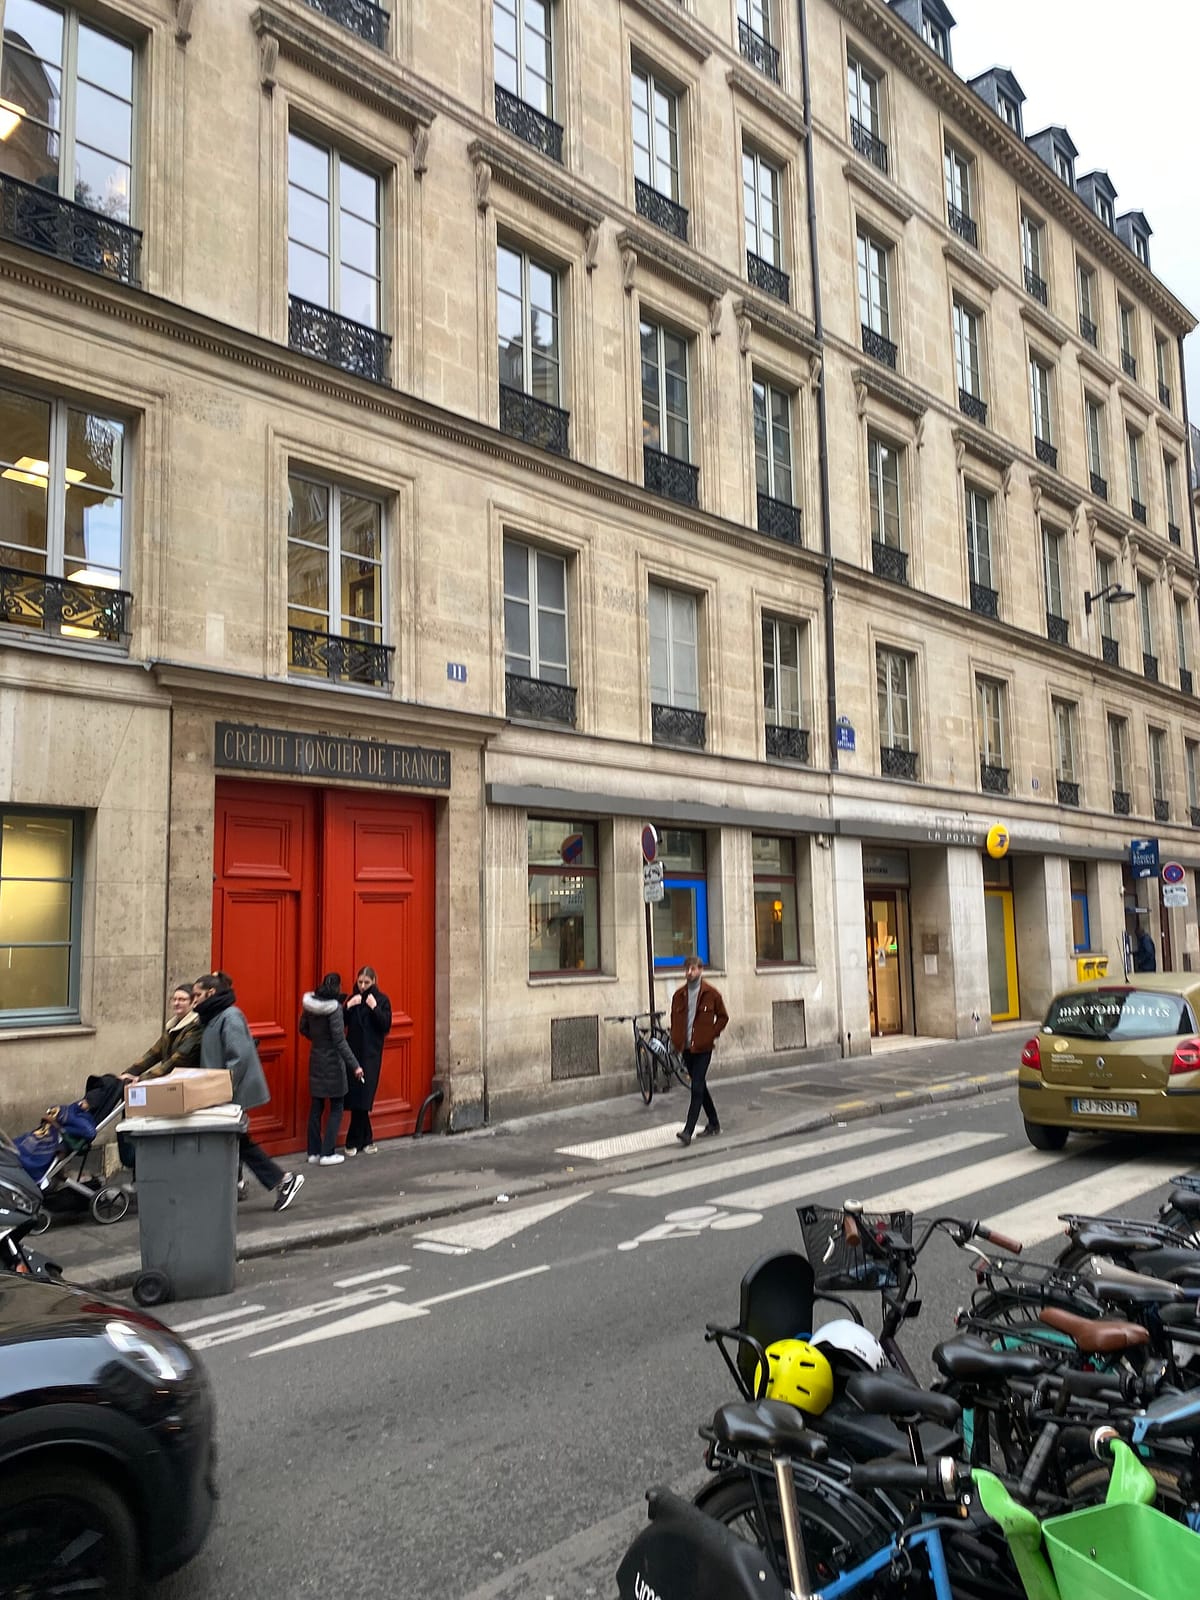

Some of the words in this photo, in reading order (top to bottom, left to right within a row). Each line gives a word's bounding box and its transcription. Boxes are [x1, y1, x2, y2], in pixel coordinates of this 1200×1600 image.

[453, 664, 462, 680] 11
[223, 730, 288, 766] CRÉDIT
[295, 737, 363, 774] FONCIER
[368, 747, 387, 777] DE
[393, 751, 447, 783] FRANCE
[928, 831, 941, 841] LA
[946, 832, 977, 844] POSTE
